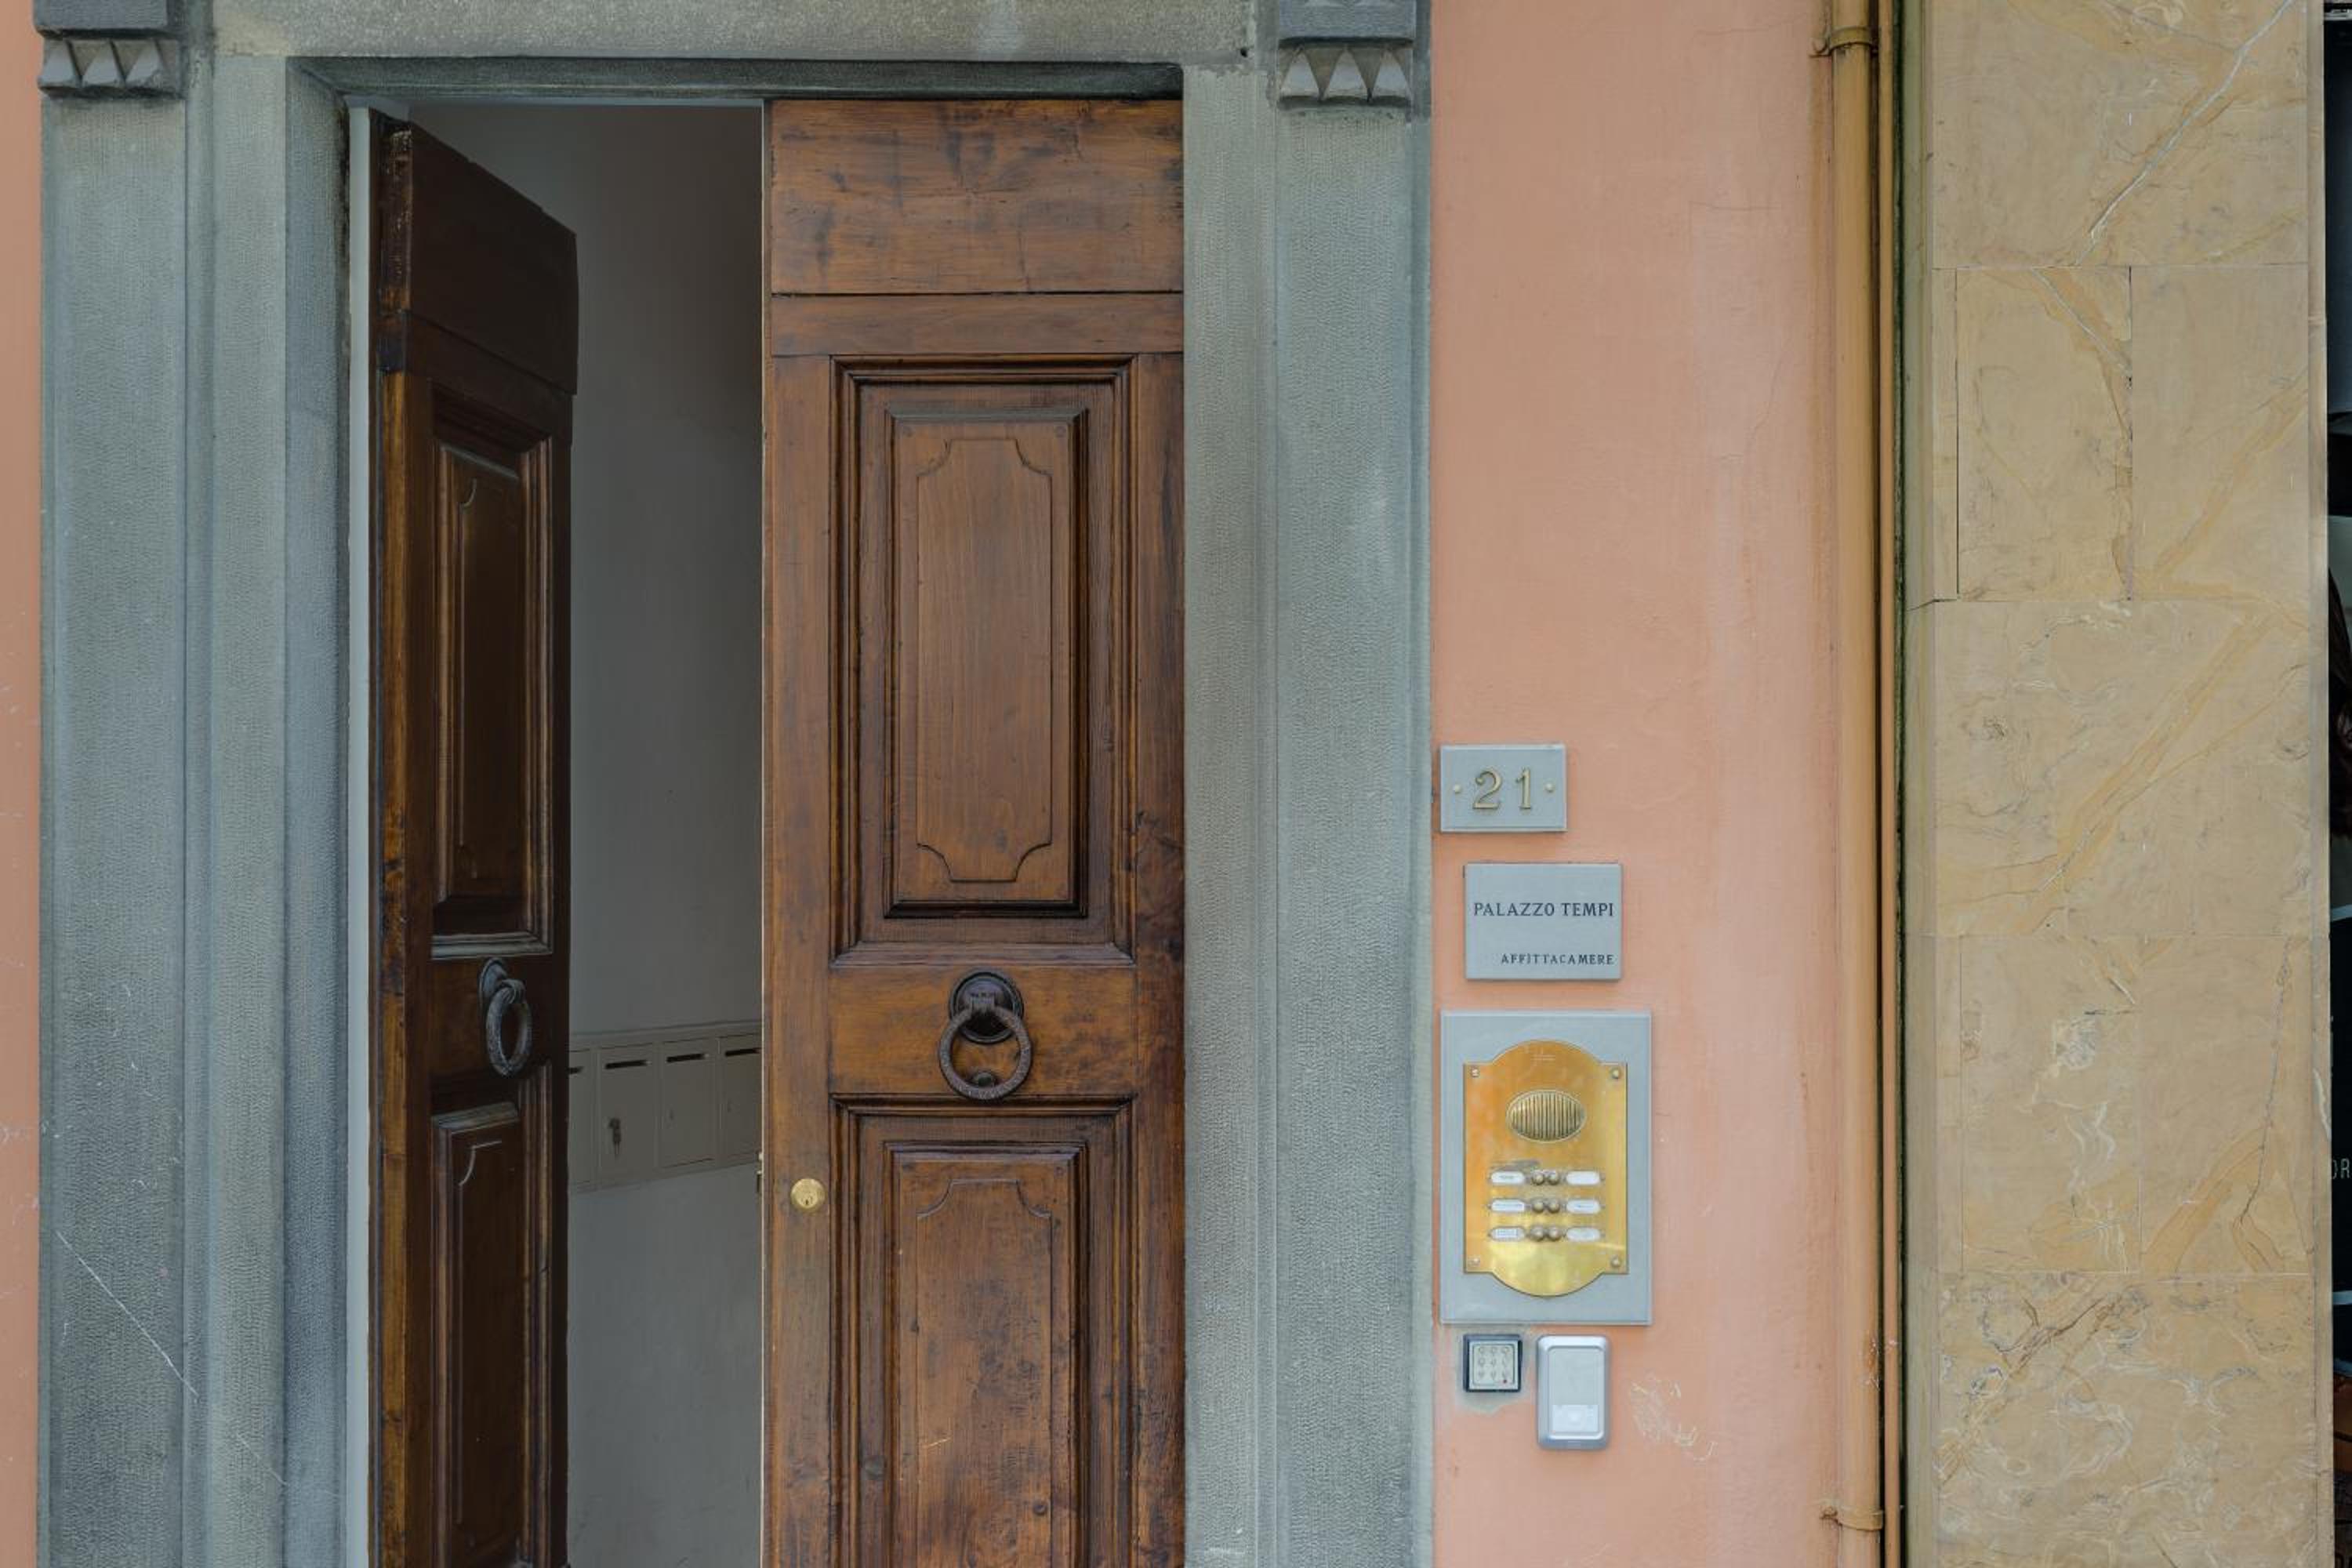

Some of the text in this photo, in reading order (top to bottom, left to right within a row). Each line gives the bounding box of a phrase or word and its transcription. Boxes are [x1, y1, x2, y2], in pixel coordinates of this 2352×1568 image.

[1472, 767, 1533, 810] 21
[1473, 902, 1615, 917] PALAZZO TEMPI
[1501, 953, 1615, 965] AFFITTACAMERE
